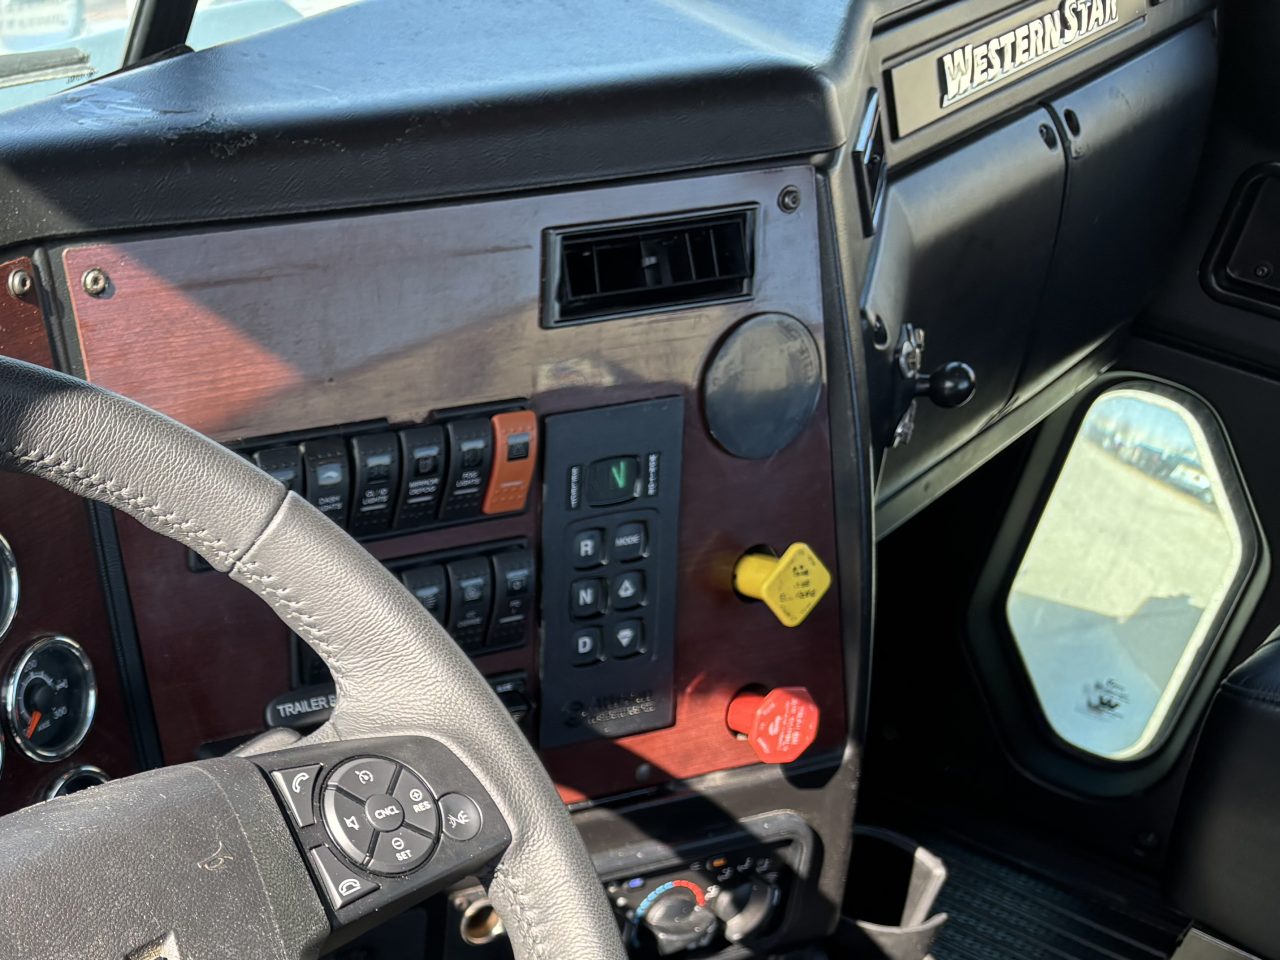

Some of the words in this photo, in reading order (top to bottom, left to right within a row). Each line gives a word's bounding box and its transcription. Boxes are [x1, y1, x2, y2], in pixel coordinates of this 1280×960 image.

[943, 10, 1061, 100] WESTERN
[580, 540, 595, 557] R
[615, 534, 640, 547] MODE
[579, 588, 593, 605] N
[578, 636, 593, 654] D
[276, 697, 328, 718] TRAILER
[375, 806, 400, 819] CNCL
[413, 801, 431, 813] RES
[396, 850, 412, 861] SET
